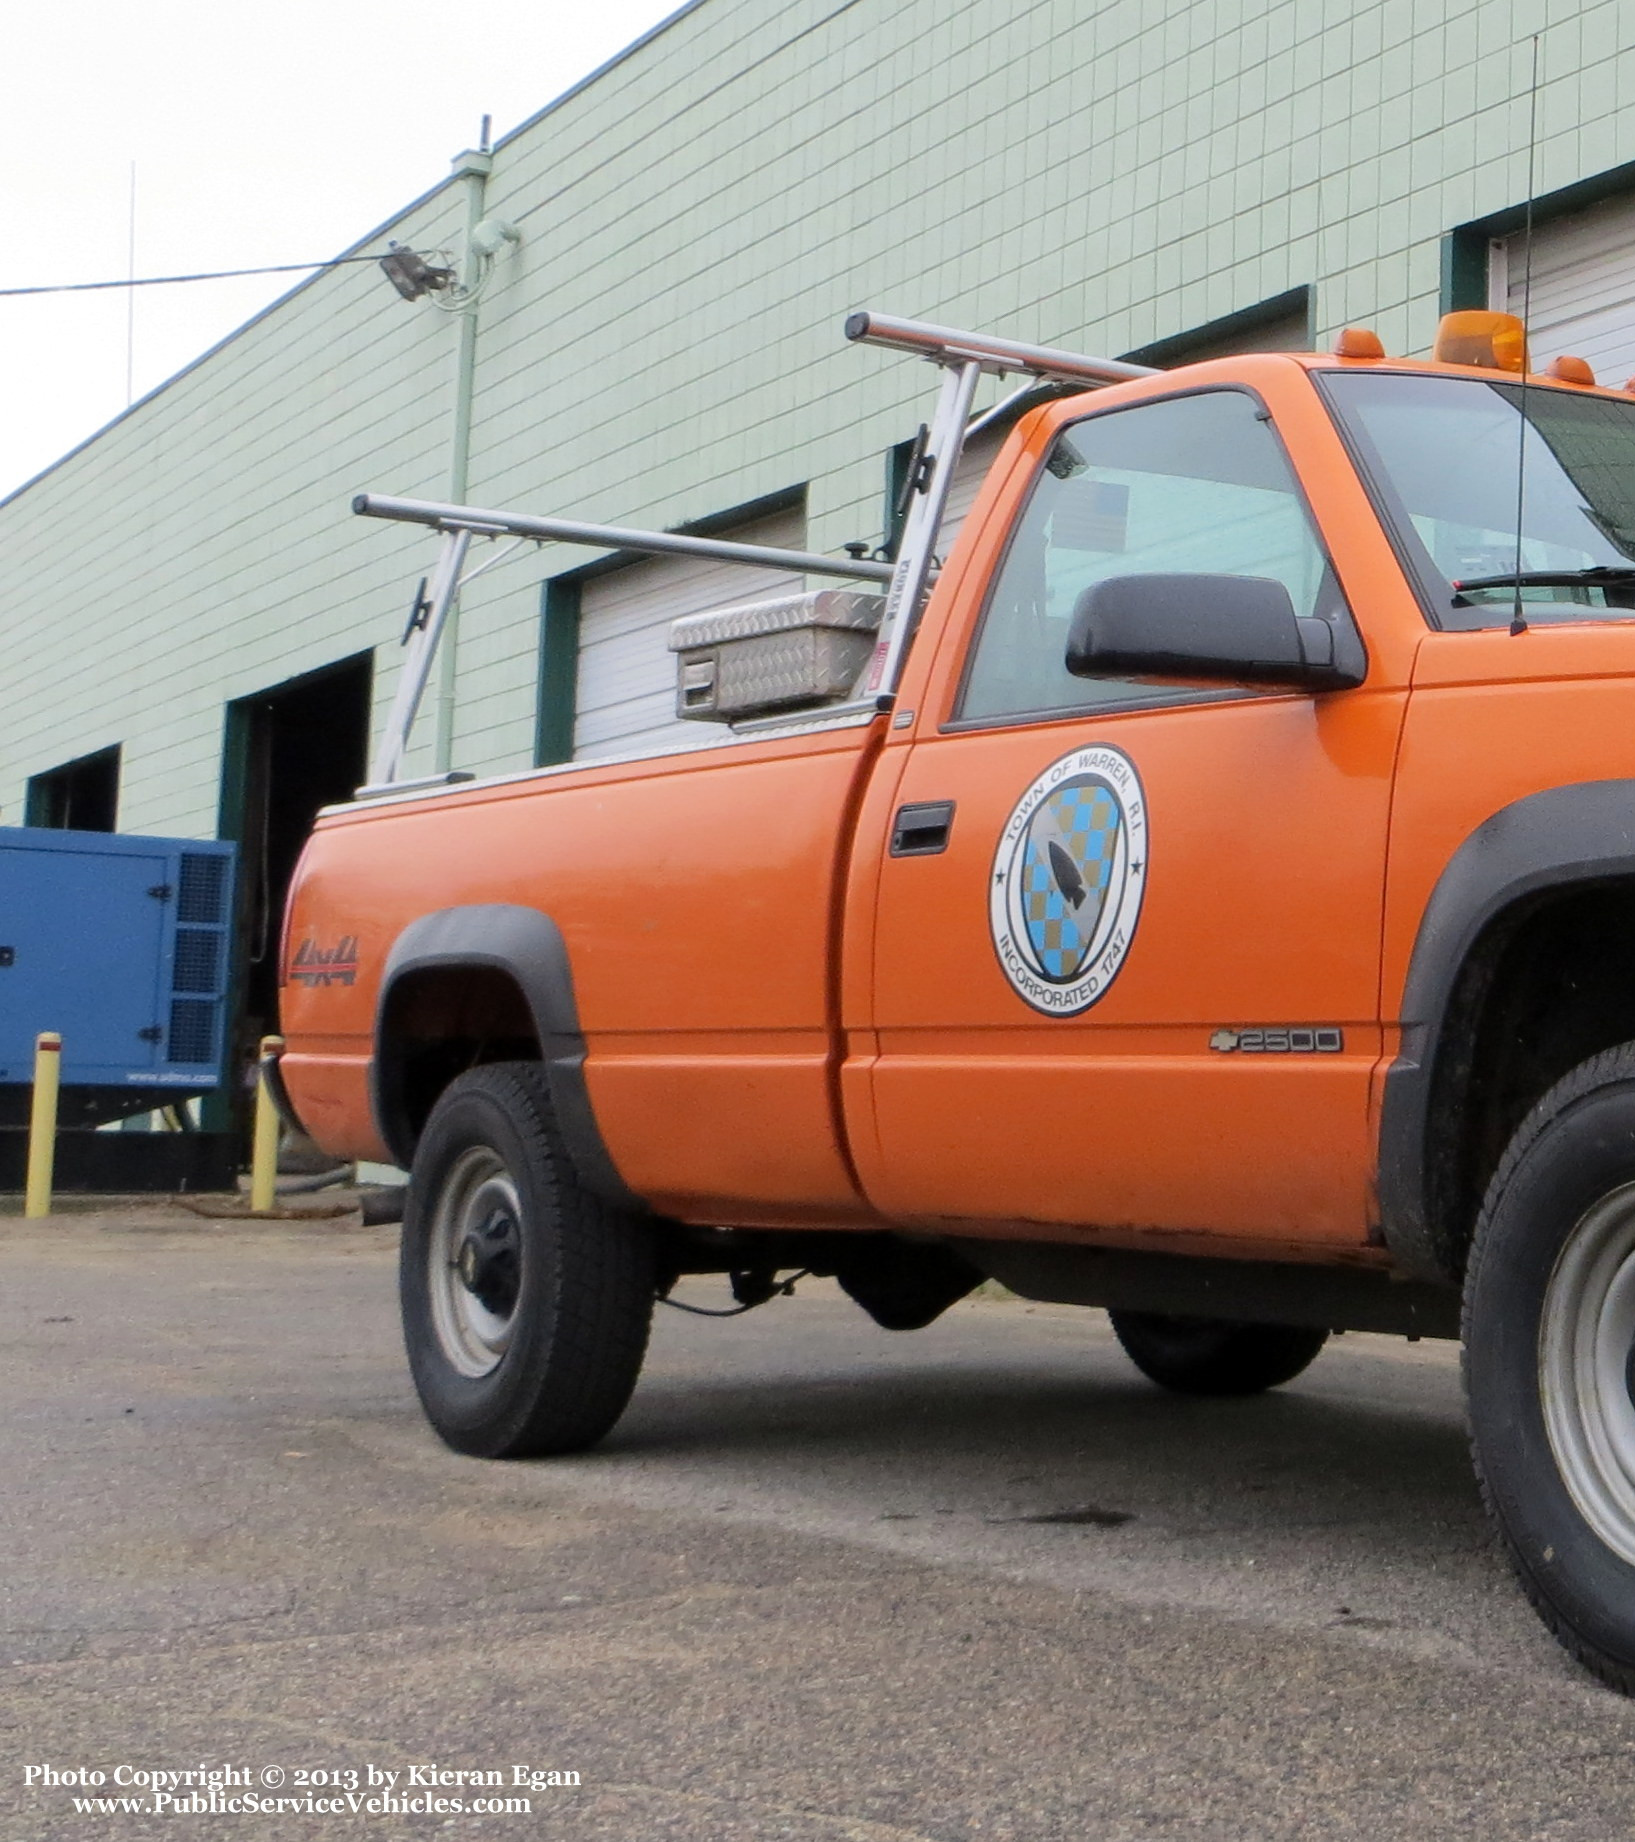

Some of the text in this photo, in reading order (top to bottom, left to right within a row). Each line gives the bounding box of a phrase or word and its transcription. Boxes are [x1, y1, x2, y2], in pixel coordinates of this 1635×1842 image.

[1005, 752, 1143, 841] TOWN OF WARREN, R.I.
[999, 928, 1127, 1008] INCORPORATED 1747
[1239, 1028, 1341, 1051] 2500
